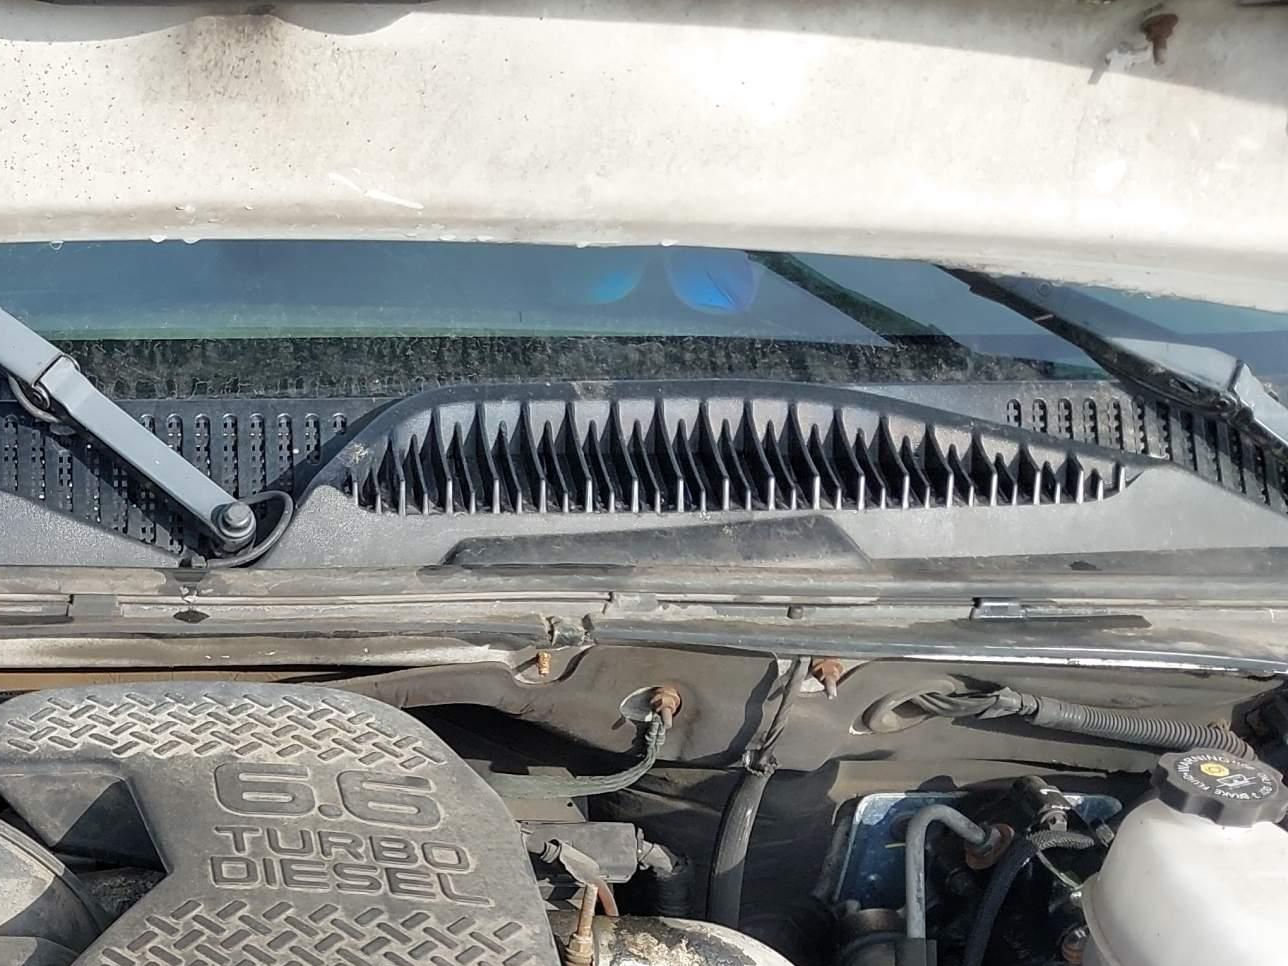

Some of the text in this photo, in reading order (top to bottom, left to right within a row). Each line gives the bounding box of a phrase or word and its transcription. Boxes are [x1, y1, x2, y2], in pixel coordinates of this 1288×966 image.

[214, 762, 445, 831] 6.6
[214, 825, 476, 874] TURBO
[210, 855, 491, 905] DIESEL
